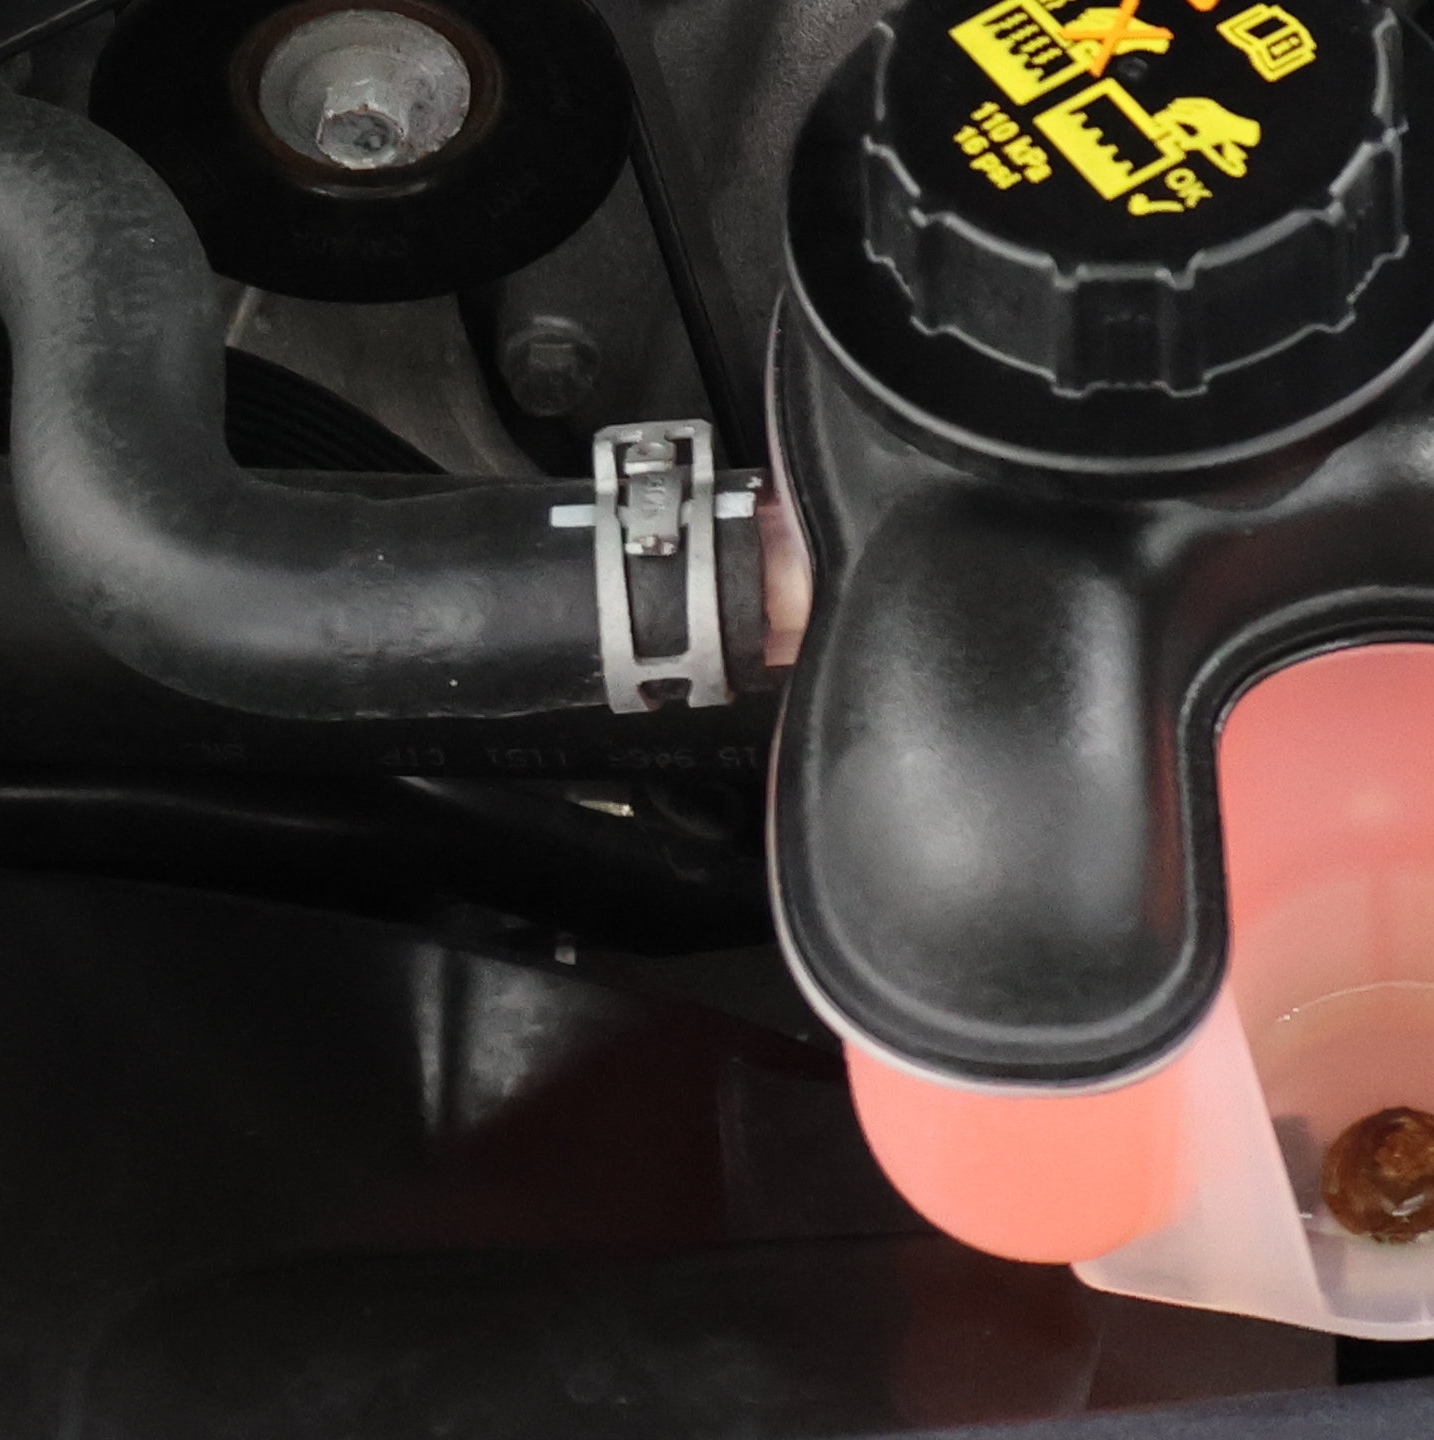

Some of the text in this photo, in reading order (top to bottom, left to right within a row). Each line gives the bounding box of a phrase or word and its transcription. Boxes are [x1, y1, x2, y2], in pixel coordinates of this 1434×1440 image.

[953, 125, 1023, 191] 16 psi
[970, 101, 1053, 184] 110 kPa
[1165, 167, 1213, 209] OK
